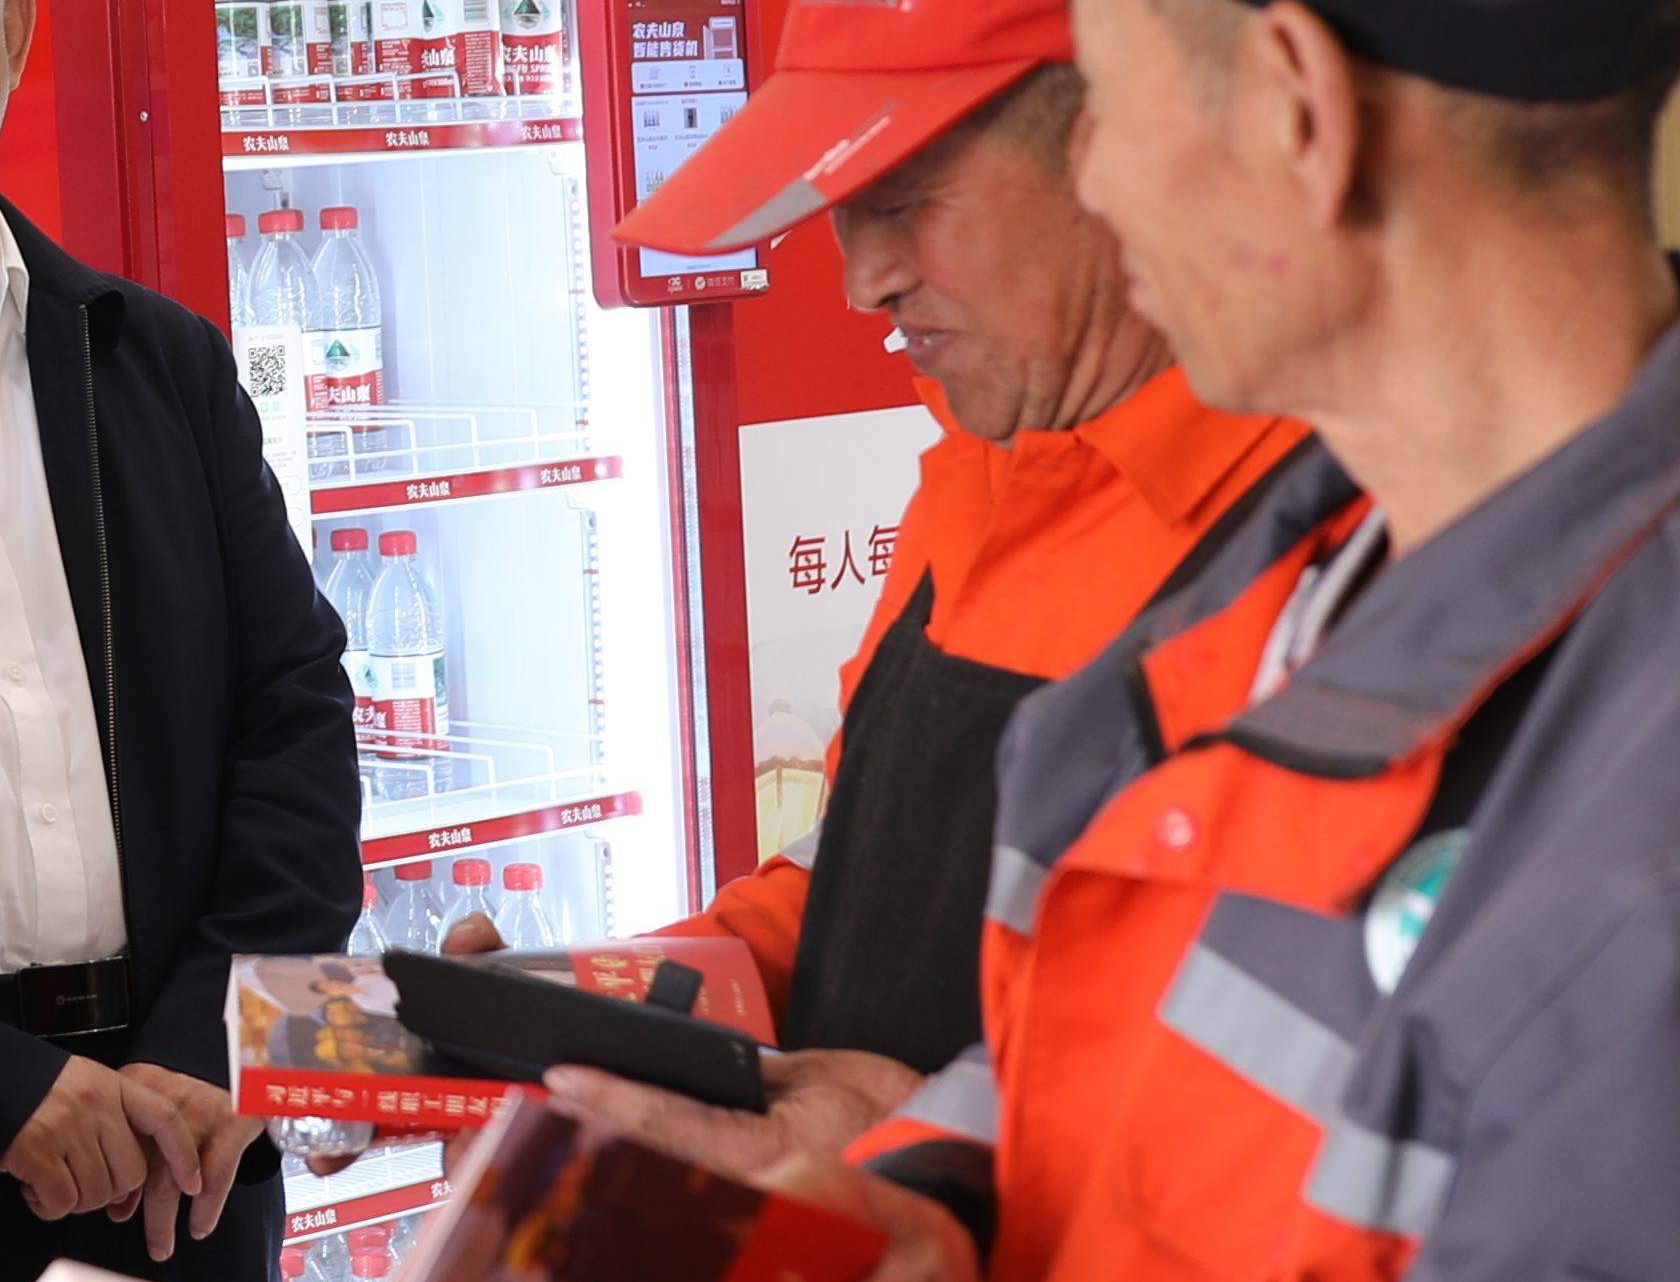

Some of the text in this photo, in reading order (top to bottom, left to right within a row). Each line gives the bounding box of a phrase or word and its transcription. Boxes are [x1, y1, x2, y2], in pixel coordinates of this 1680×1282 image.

[633, 22, 685, 39] 农夫山泉
[385, 129, 430, 148] 农夫山泉
[520, 123, 563, 142] 农夫山泉
[243, 133, 289, 152] 农夫山泉
[540, 464, 581, 483] 农夫山泉
[406, 479, 451, 499] 农夫山泉
[561, 802, 602, 822] 农夫山泉
[428, 827, 472, 847] 农夫山泉
[291, 1209, 338, 1232] 农夫山泉
